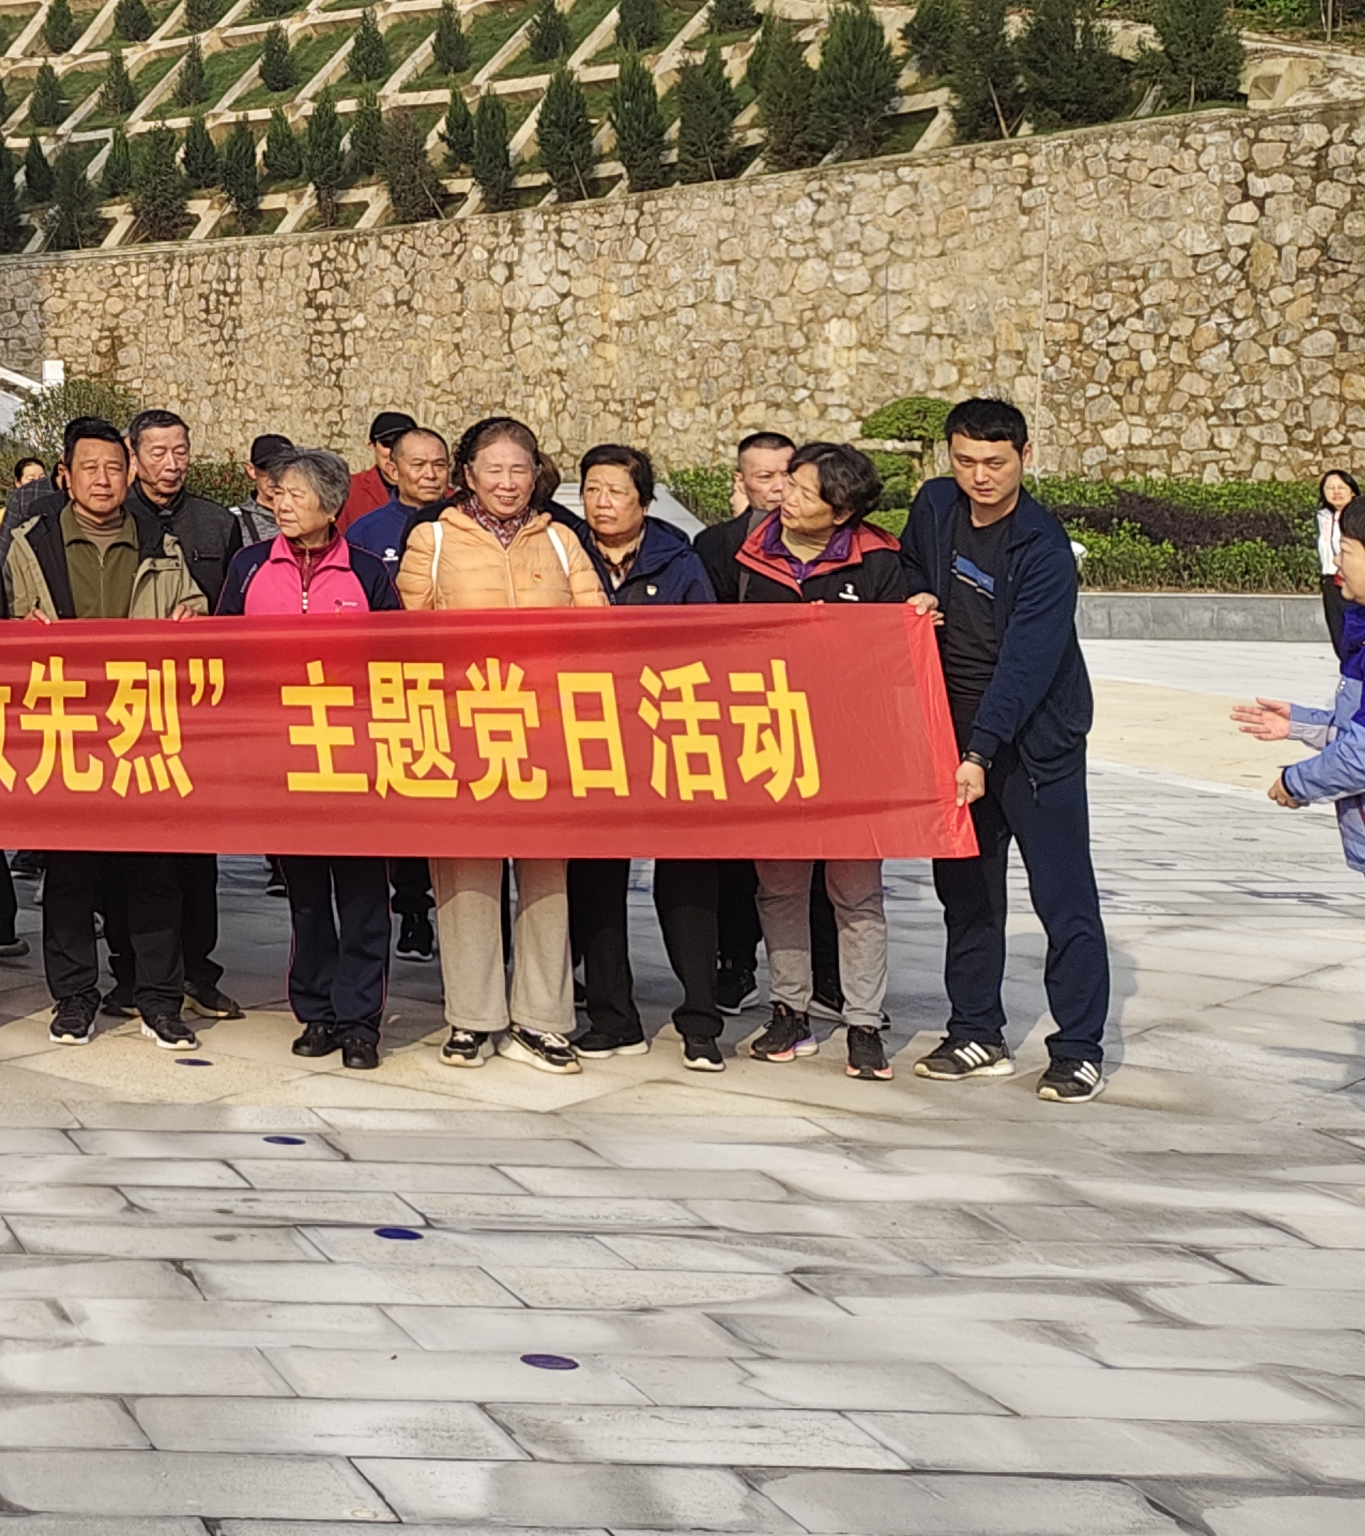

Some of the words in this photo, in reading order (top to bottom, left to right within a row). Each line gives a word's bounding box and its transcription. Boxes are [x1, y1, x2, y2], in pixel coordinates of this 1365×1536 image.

[280, 658, 820, 802] 主题党日活动
